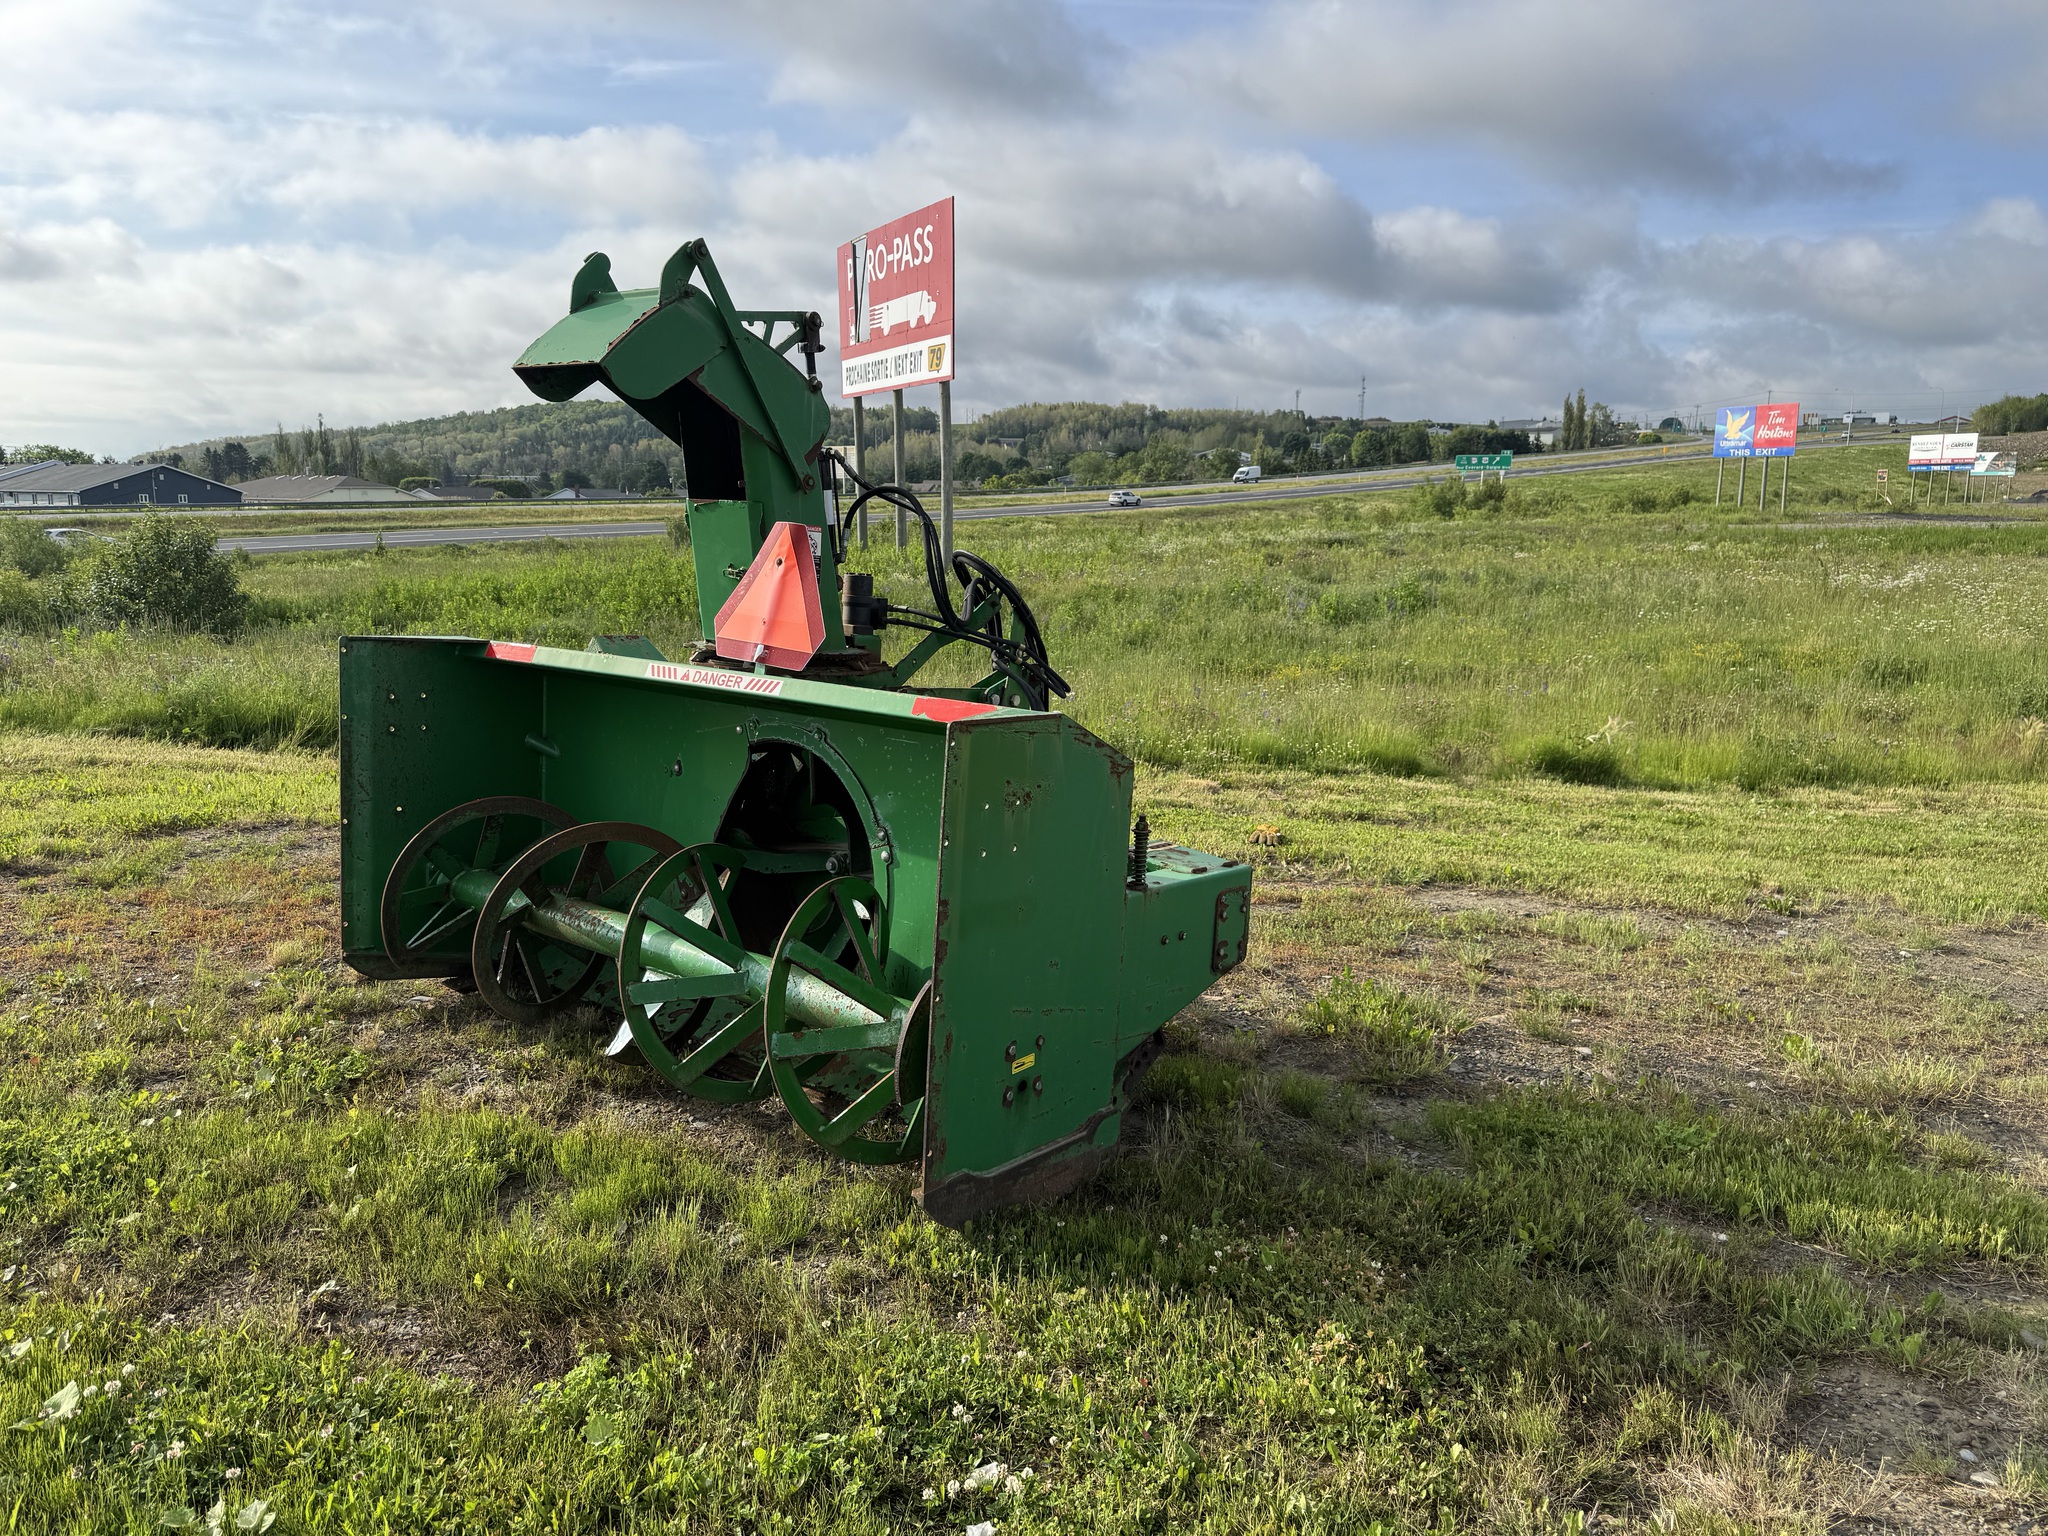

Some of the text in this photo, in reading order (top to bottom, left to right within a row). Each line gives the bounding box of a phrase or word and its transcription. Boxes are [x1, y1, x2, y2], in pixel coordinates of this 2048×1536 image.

[847, 224, 933, 292] PRO-PASS
[845, 362, 870, 386] PROCHAINE
[871, 358, 888, 382] SORTIE
[894, 353, 908, 377] NEXT
[909, 350, 923, 374] EXIT
[930, 347, 942, 369] 79
[1768, 410, 1785, 424] Tim
[1757, 425, 1793, 439] Hortons
[692, 671, 743, 689] DANGER
